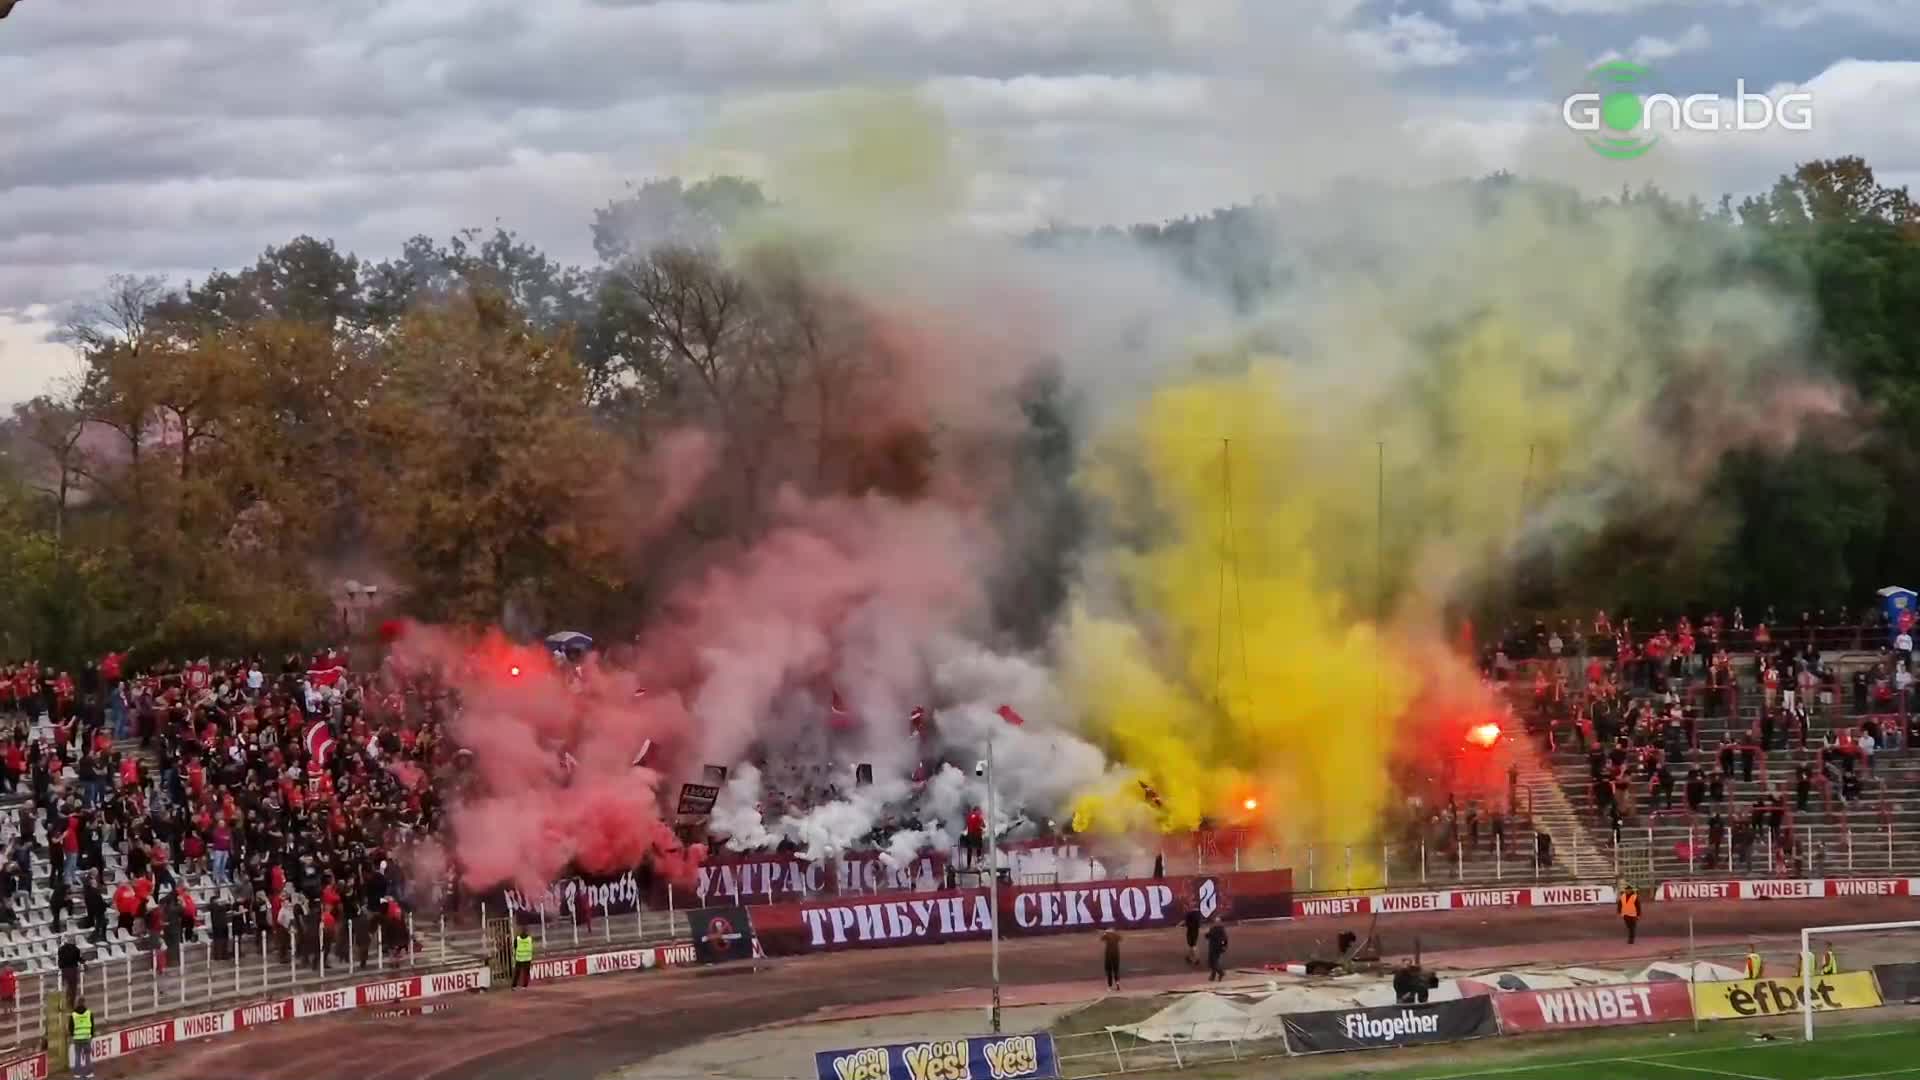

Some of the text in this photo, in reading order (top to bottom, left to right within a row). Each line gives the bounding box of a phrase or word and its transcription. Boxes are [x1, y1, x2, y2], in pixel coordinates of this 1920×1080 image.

[696, 860, 825, 898] УЛТРАС
[1752, 881, 1812, 898] WINBET
[1835, 880, 1897, 896] WINBET
[1382, 894, 1438, 909] WINBET
[1462, 890, 1520, 906] WINBET
[1543, 888, 1600, 902] WINBET
[1668, 883, 1729, 899] WINBET
[802, 895, 992, 946] ТРИБУНА
[1014, 884, 1173, 928] СЕКТОР
[1302, 899, 1359, 914] WINBET
[597, 951, 645, 971] WINBET
[664, 947, 697, 963] WINB
[529, 958, 578, 980] WINBET
[364, 980, 412, 1003] WINBET
[431, 972, 480, 992] WINBET
[302, 991, 346, 1013] WINBET
[1536, 987, 1654, 1024] WINBET
[242, 1002, 286, 1025] WINBET
[183, 1014, 225, 1037] WINBET
[1346, 1010, 1439, 1040] Fitogether
[127, 1025, 166, 1049] WINBET
